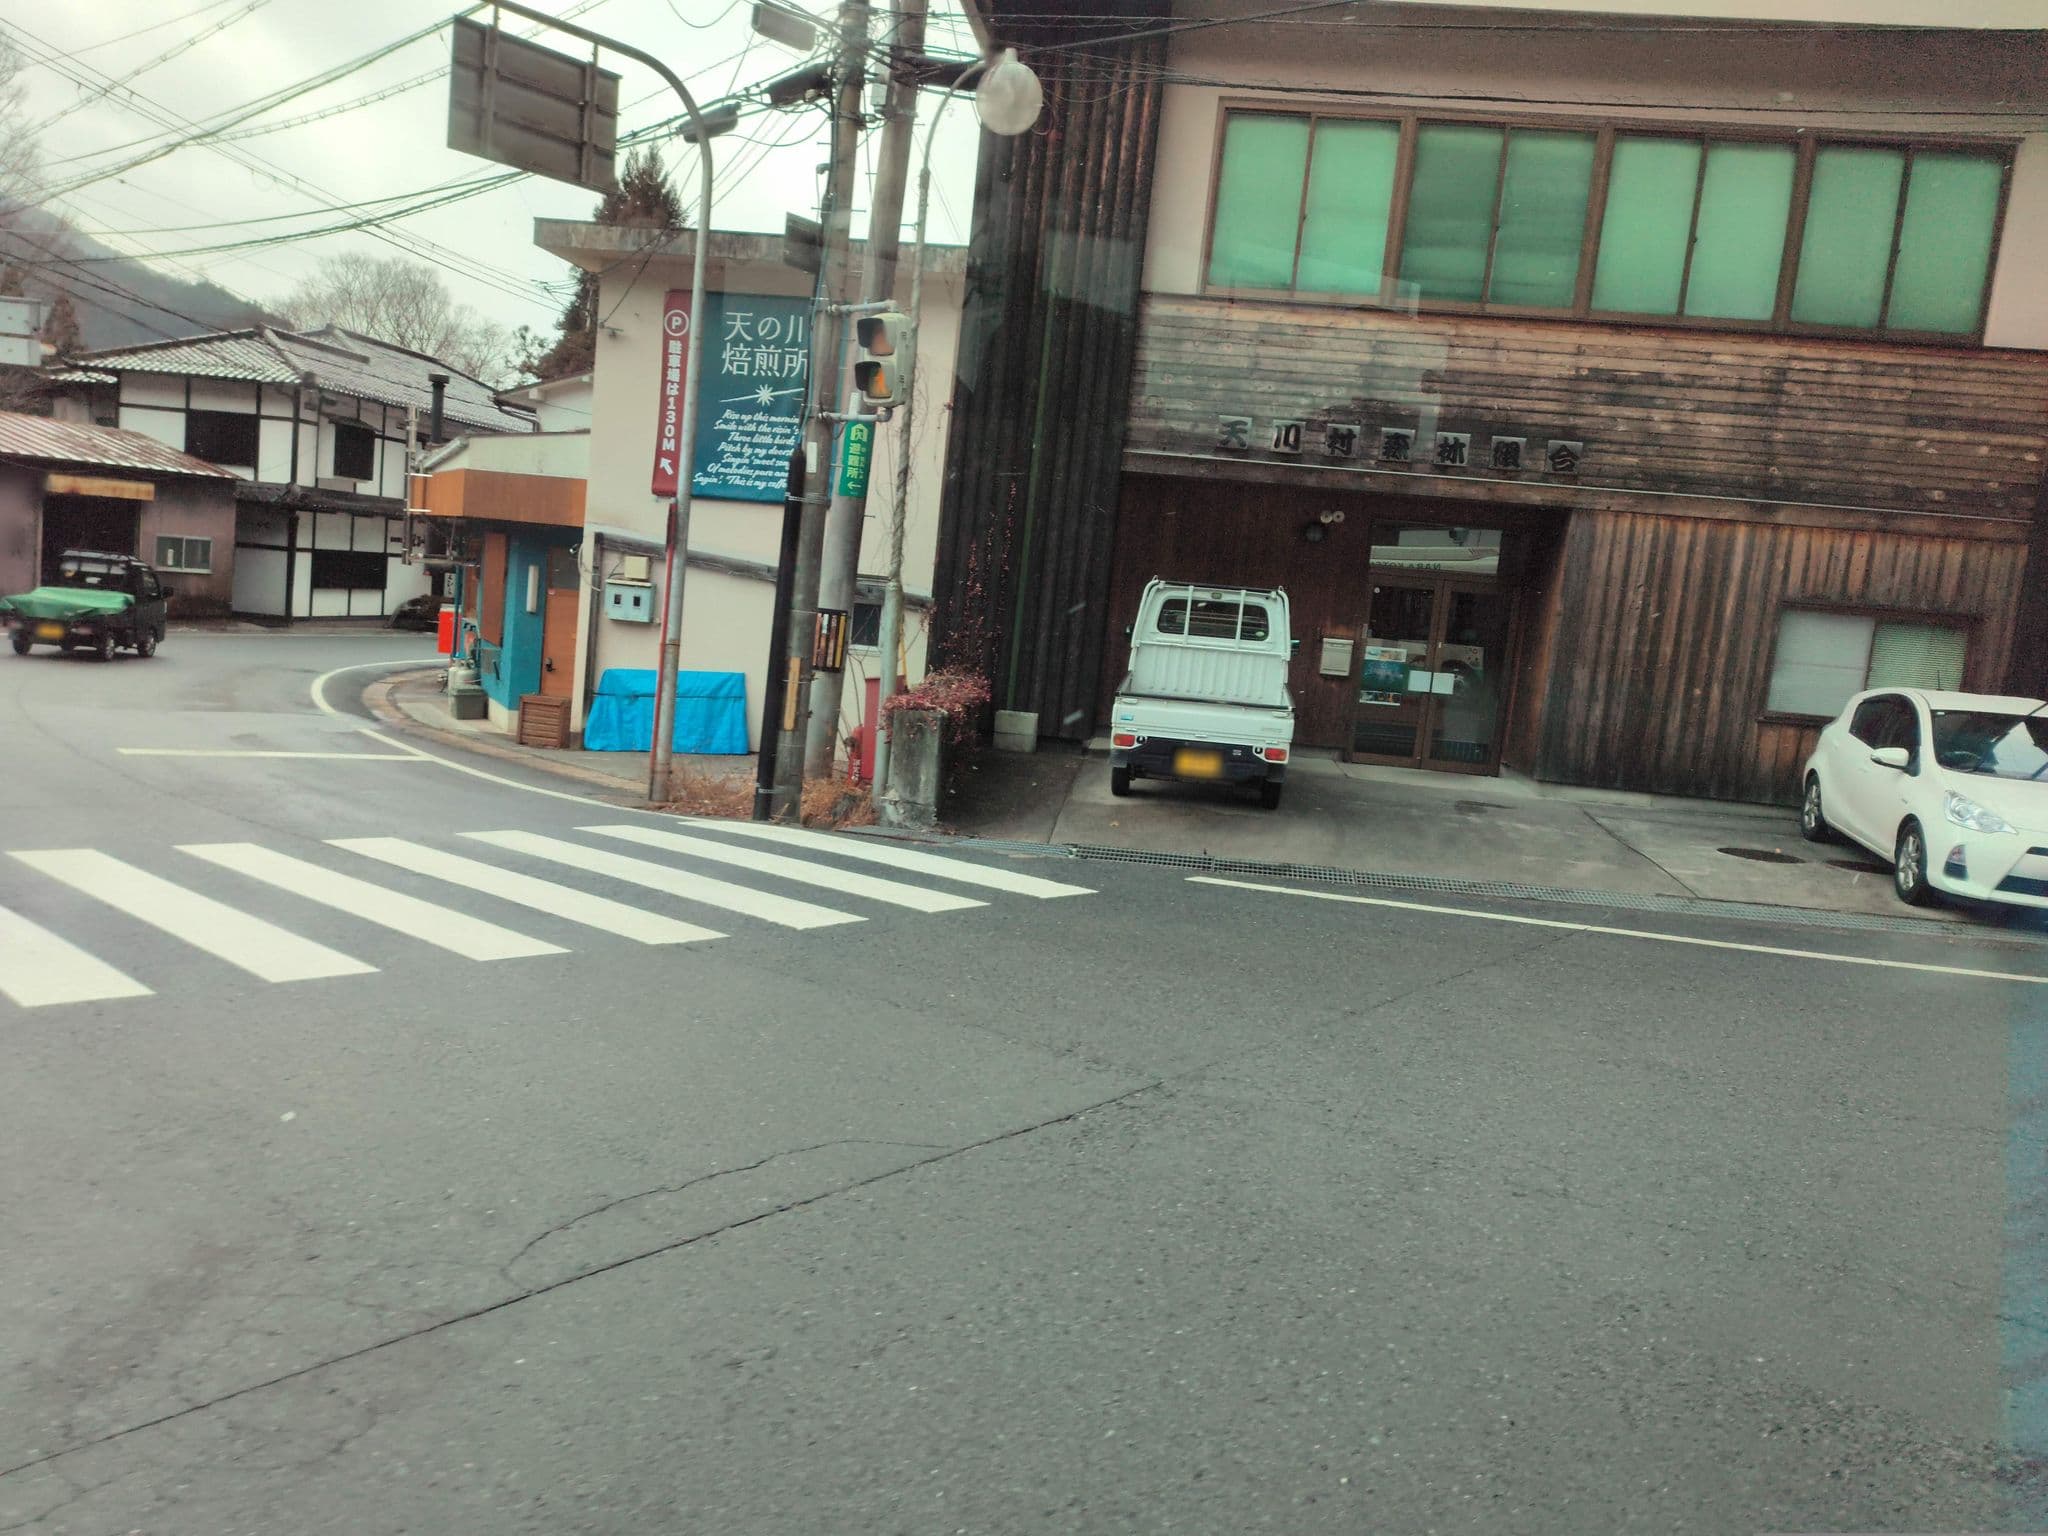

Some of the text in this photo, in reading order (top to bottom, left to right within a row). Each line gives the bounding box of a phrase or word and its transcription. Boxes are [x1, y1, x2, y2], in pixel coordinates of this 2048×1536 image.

[724, 312, 803, 343] 天の川
[721, 342, 808, 380] 焙煎所
[740, 414, 753, 423] up
[753, 411, 769, 422] this
[738, 422, 756, 432] with
[757, 423, 772, 432] the
[728, 432, 752, 442] Three
[752, 433, 773, 444] little
[742, 443, 753, 456] by
[754, 448, 767, 457] my
[707, 463, 721, 474] Of
[718, 464, 754, 476] melodies
[753, 480, 767, 490] my
[768, 478, 788, 489] coffe
